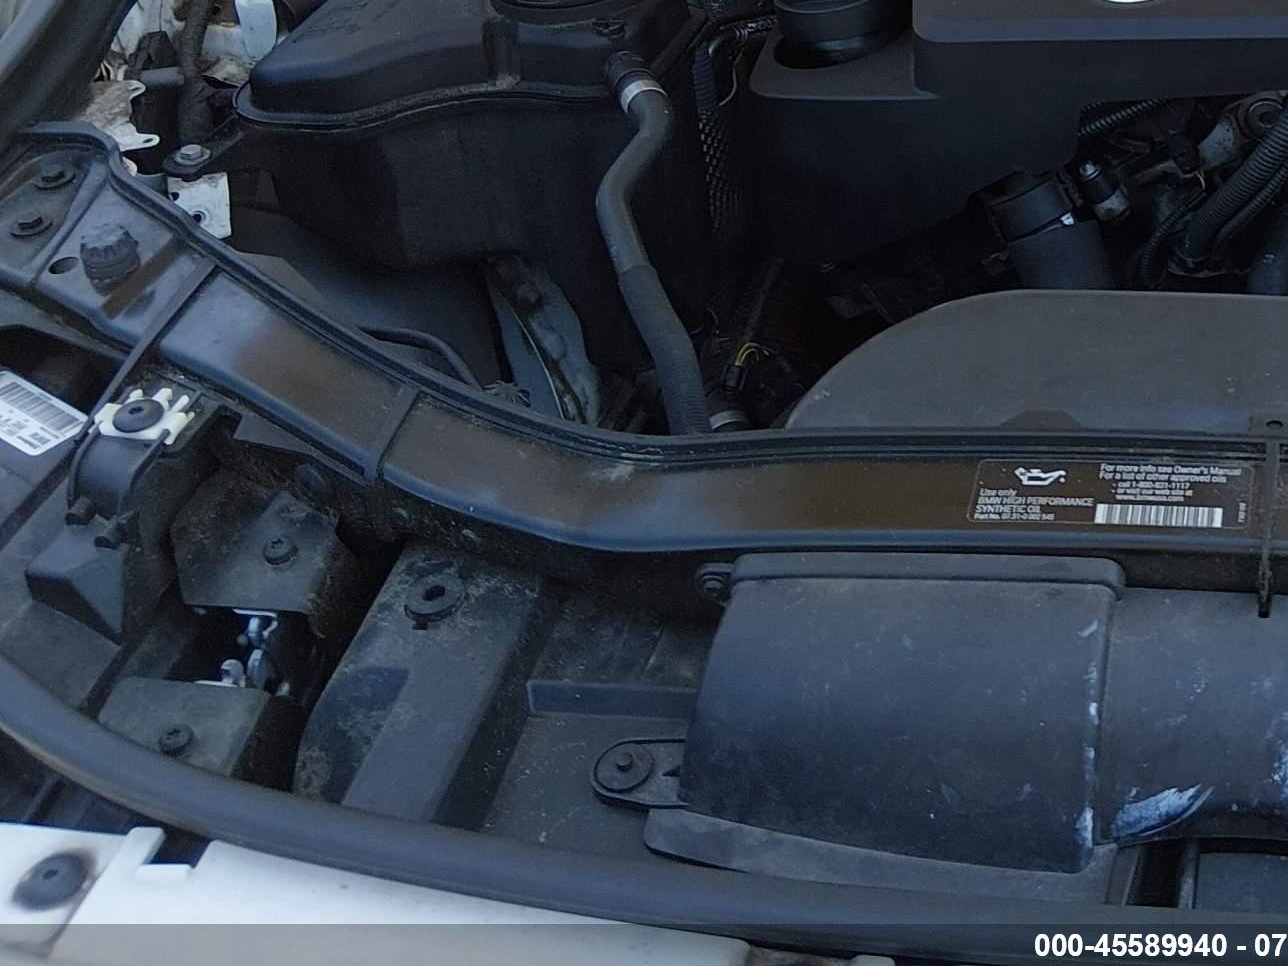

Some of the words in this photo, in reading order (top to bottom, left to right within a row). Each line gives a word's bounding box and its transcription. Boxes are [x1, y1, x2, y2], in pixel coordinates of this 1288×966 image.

[1100, 463, 1114, 472] For
[1116, 465, 1138, 473] more
[1140, 464, 1156, 473] info
[1158, 466, 1173, 474] see
[1174, 465, 1208, 475] Owner's
[1210, 466, 1242, 476] Manual
[1099, 471, 1114, 480] For
[1122, 472, 1135, 480] list
[1135, 472, 1145, 480] of
[1146, 473, 1169, 481] other
[1170, 474, 1210, 483] approved
[1211, 475, 1227, 483] oils
[980, 488, 997, 496] Use
[998, 488, 1018, 498] only
[978, 496, 1002, 504] BMW
[1002, 496, 1026, 505] HIGH
[1026, 497, 1095, 507] PERFORMANCE
[976, 504, 1027, 513] SYNTHETIC
[1027, 505, 1042, 514] OIL
